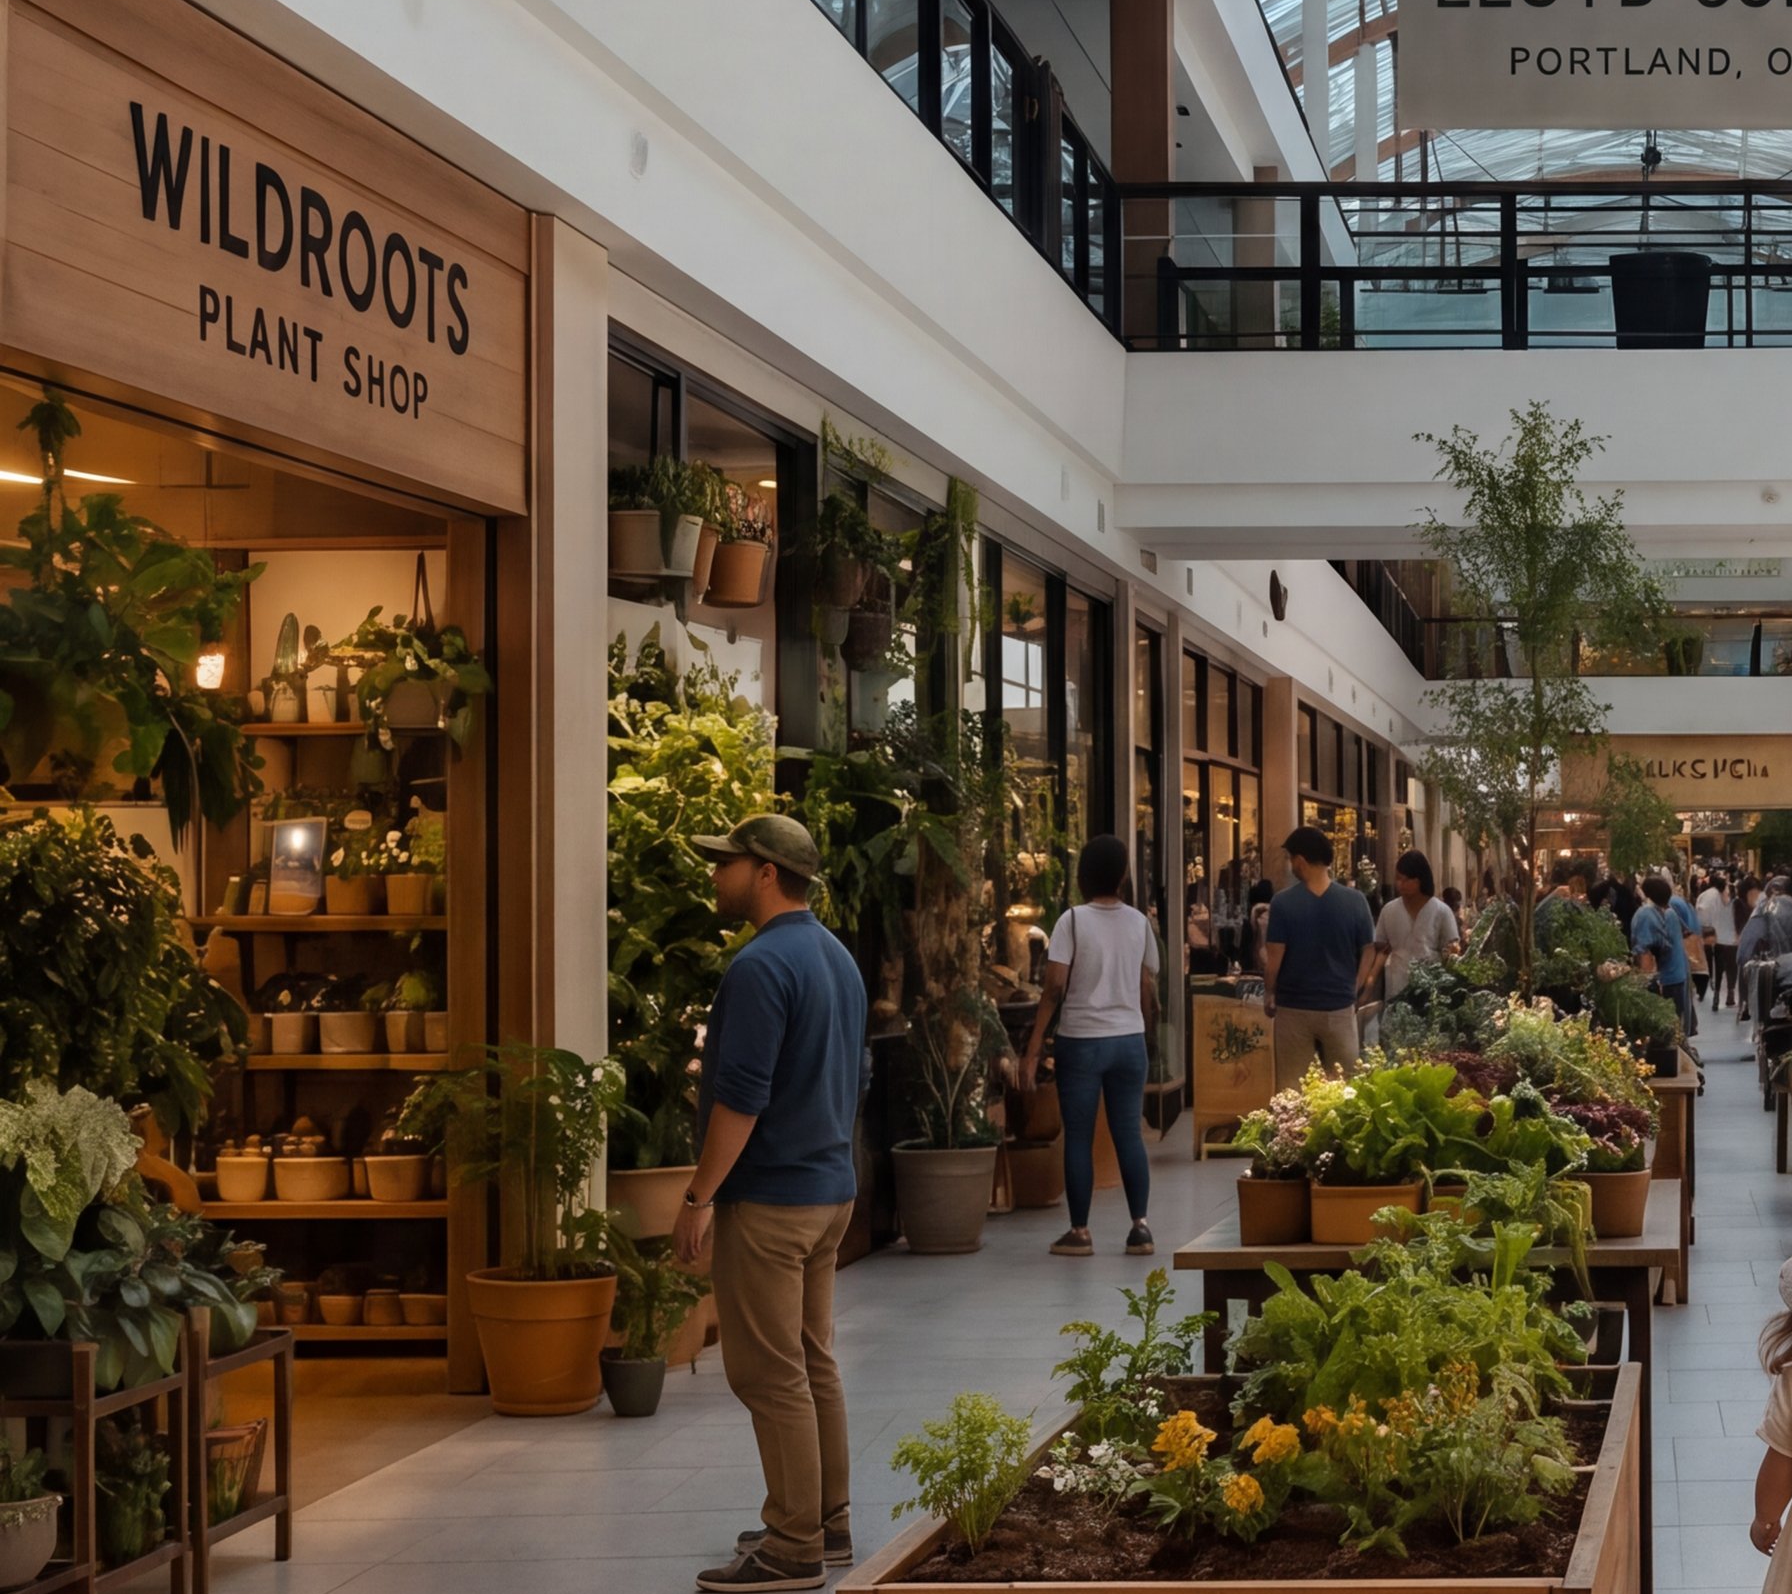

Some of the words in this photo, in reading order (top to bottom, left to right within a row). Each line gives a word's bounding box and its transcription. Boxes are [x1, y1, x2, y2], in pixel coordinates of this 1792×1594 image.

[1510, 47, 1742, 79] PORTLAND,
[129, 100, 469, 356] WILDROOTS
[199, 283, 323, 383] PLANT
[343, 345, 429, 420] SHOP
